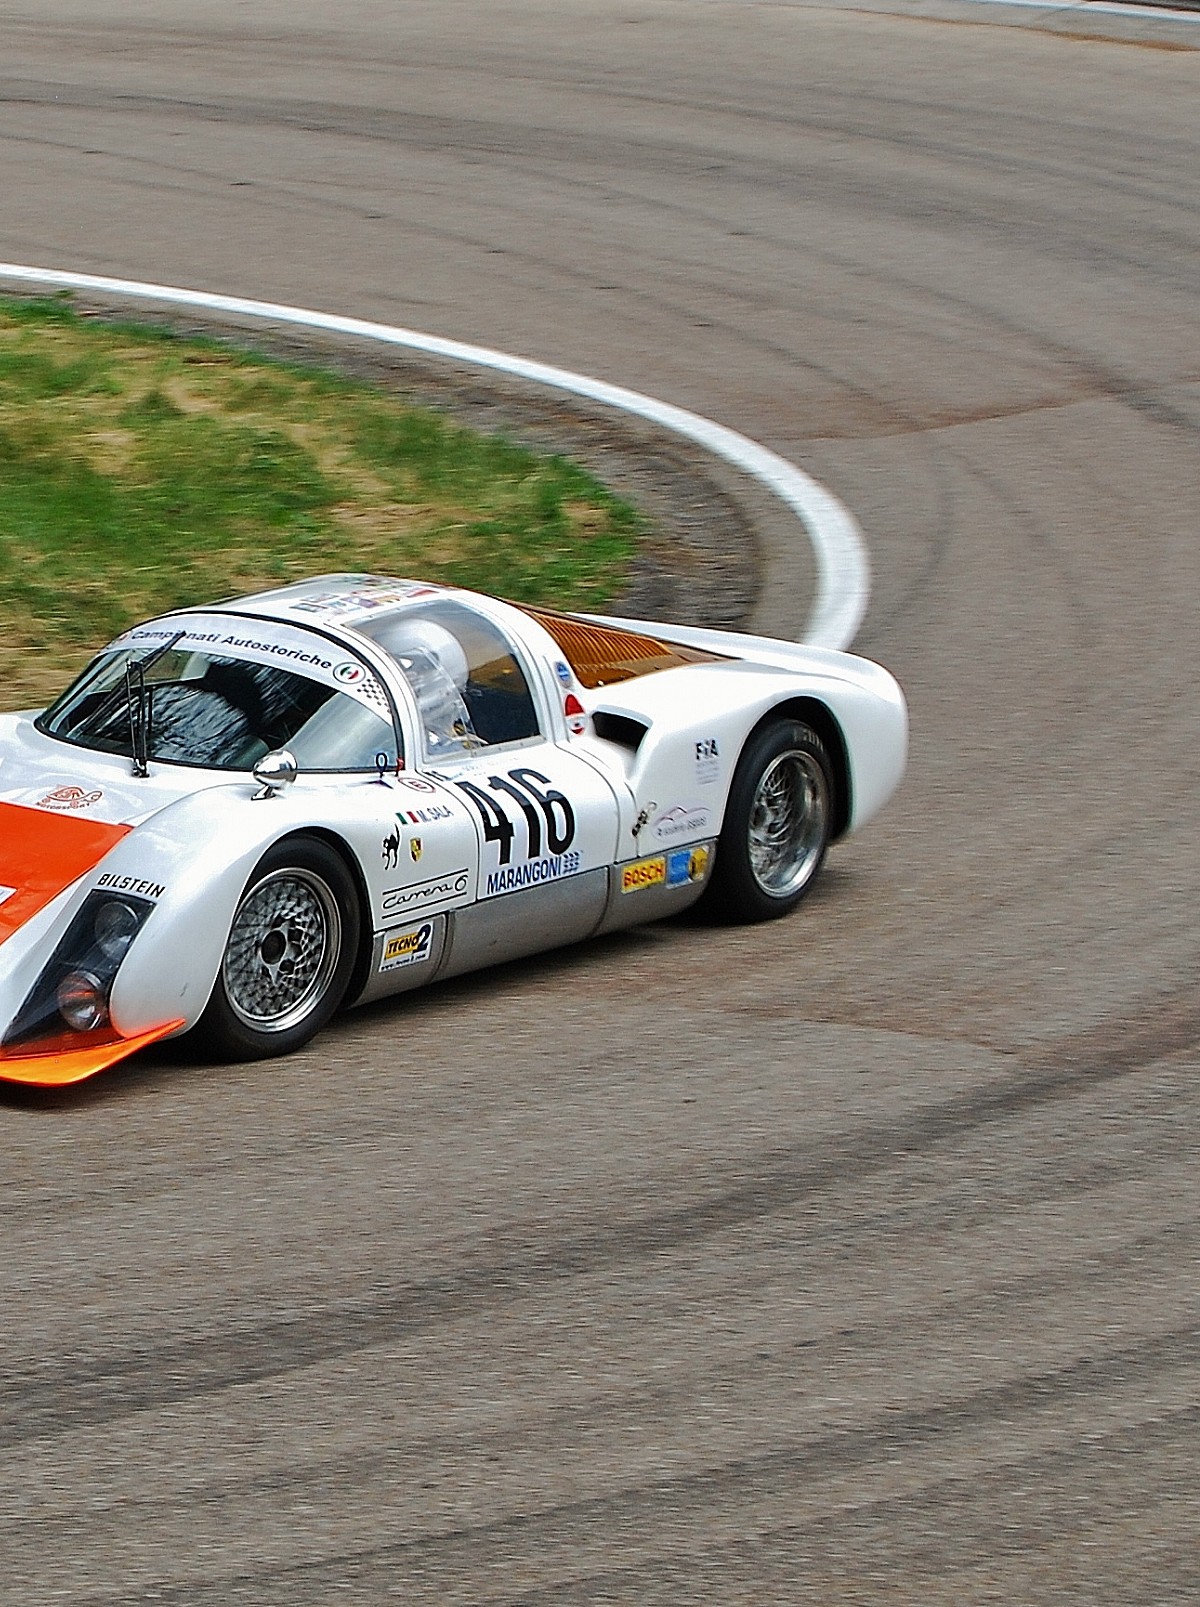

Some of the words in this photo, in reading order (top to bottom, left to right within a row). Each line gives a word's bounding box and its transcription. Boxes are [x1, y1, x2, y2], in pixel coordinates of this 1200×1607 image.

[221, 635, 332, 669] Autostoriche
[454, 768, 575, 866] 416
[97, 873, 166, 898] BILSTEIN
[382, 883, 453, 910] Carrera
[454, 874, 469, 892] 6
[487, 856, 562, 894] MARANGONI
[624, 863, 663, 887] BOSCH
